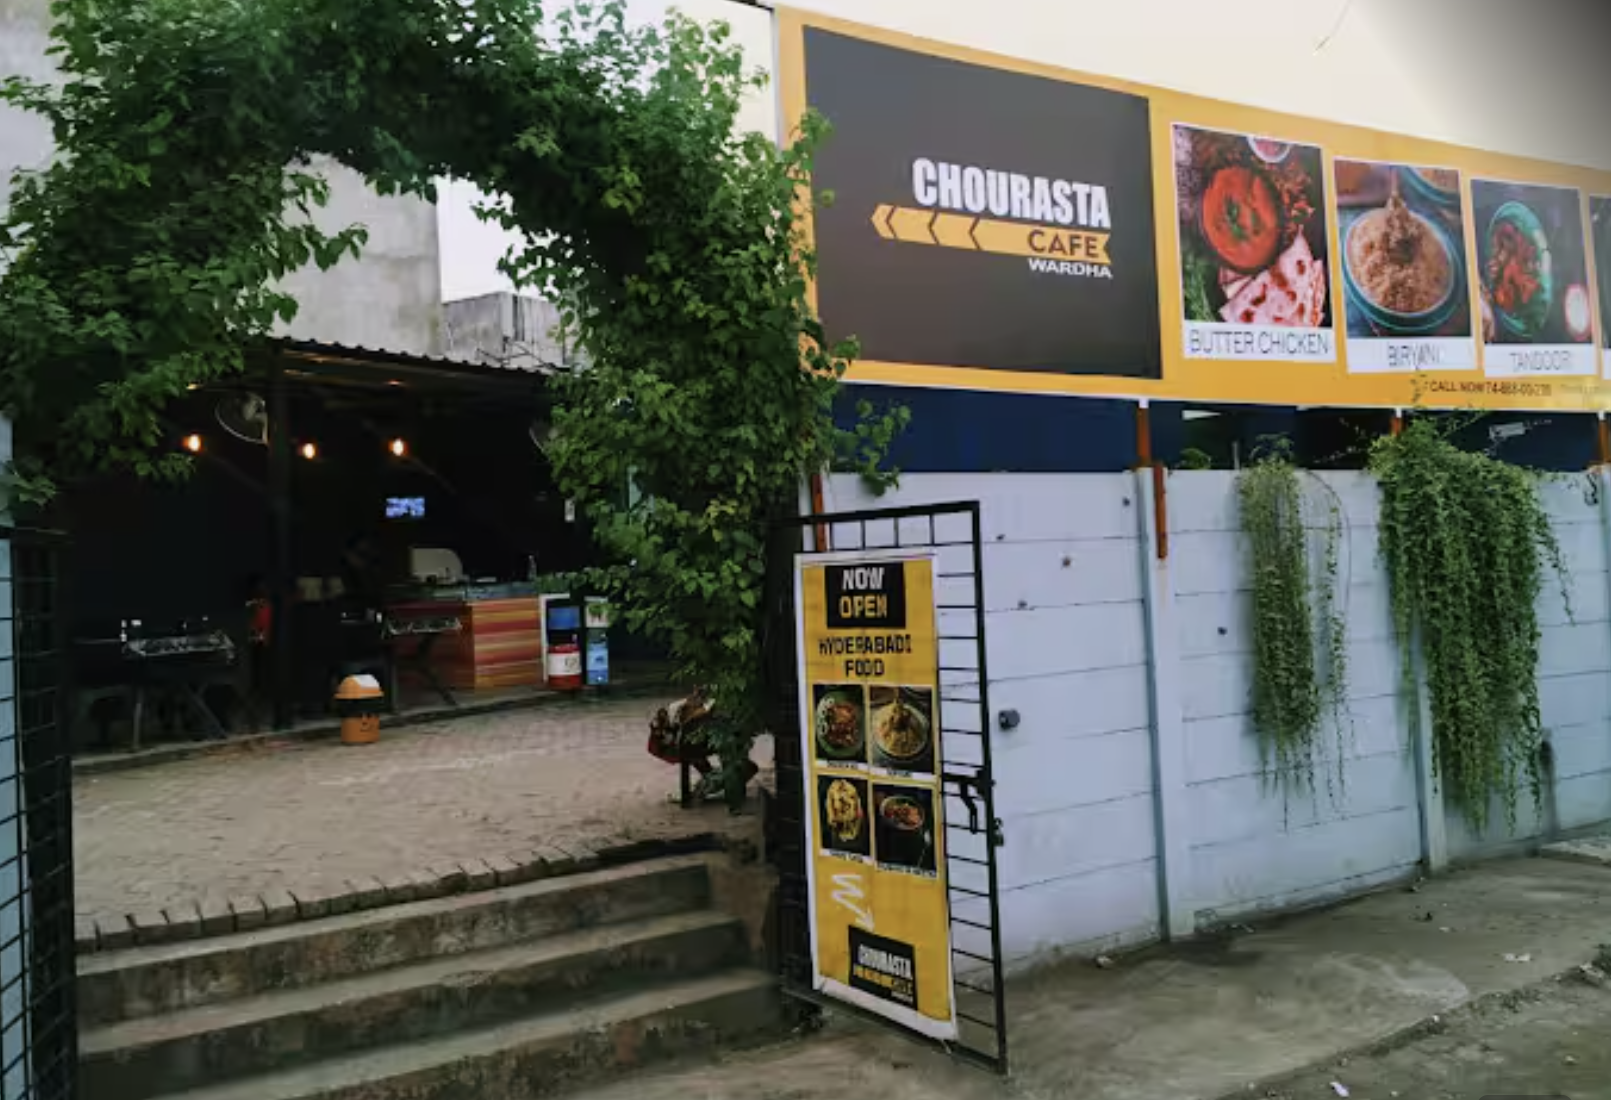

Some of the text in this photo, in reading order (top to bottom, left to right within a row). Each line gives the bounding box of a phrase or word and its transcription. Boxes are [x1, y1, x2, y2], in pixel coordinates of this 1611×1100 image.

[912, 157, 1112, 229] CHOURASTA
[1027, 229, 1099, 258] CAFE
[1028, 257, 1113, 279] WARDHA
[1190, 329, 1329, 355] BUTTER CHICKEN
[1430, 380, 1457, 393] CALL
[1459, 381, 1485, 394] NOW
[842, 567, 885, 591] NOW
[840, 595, 888, 619] OPEN
[819, 634, 912, 655] HYDERABADI
[845, 658, 885, 677] FOOD
